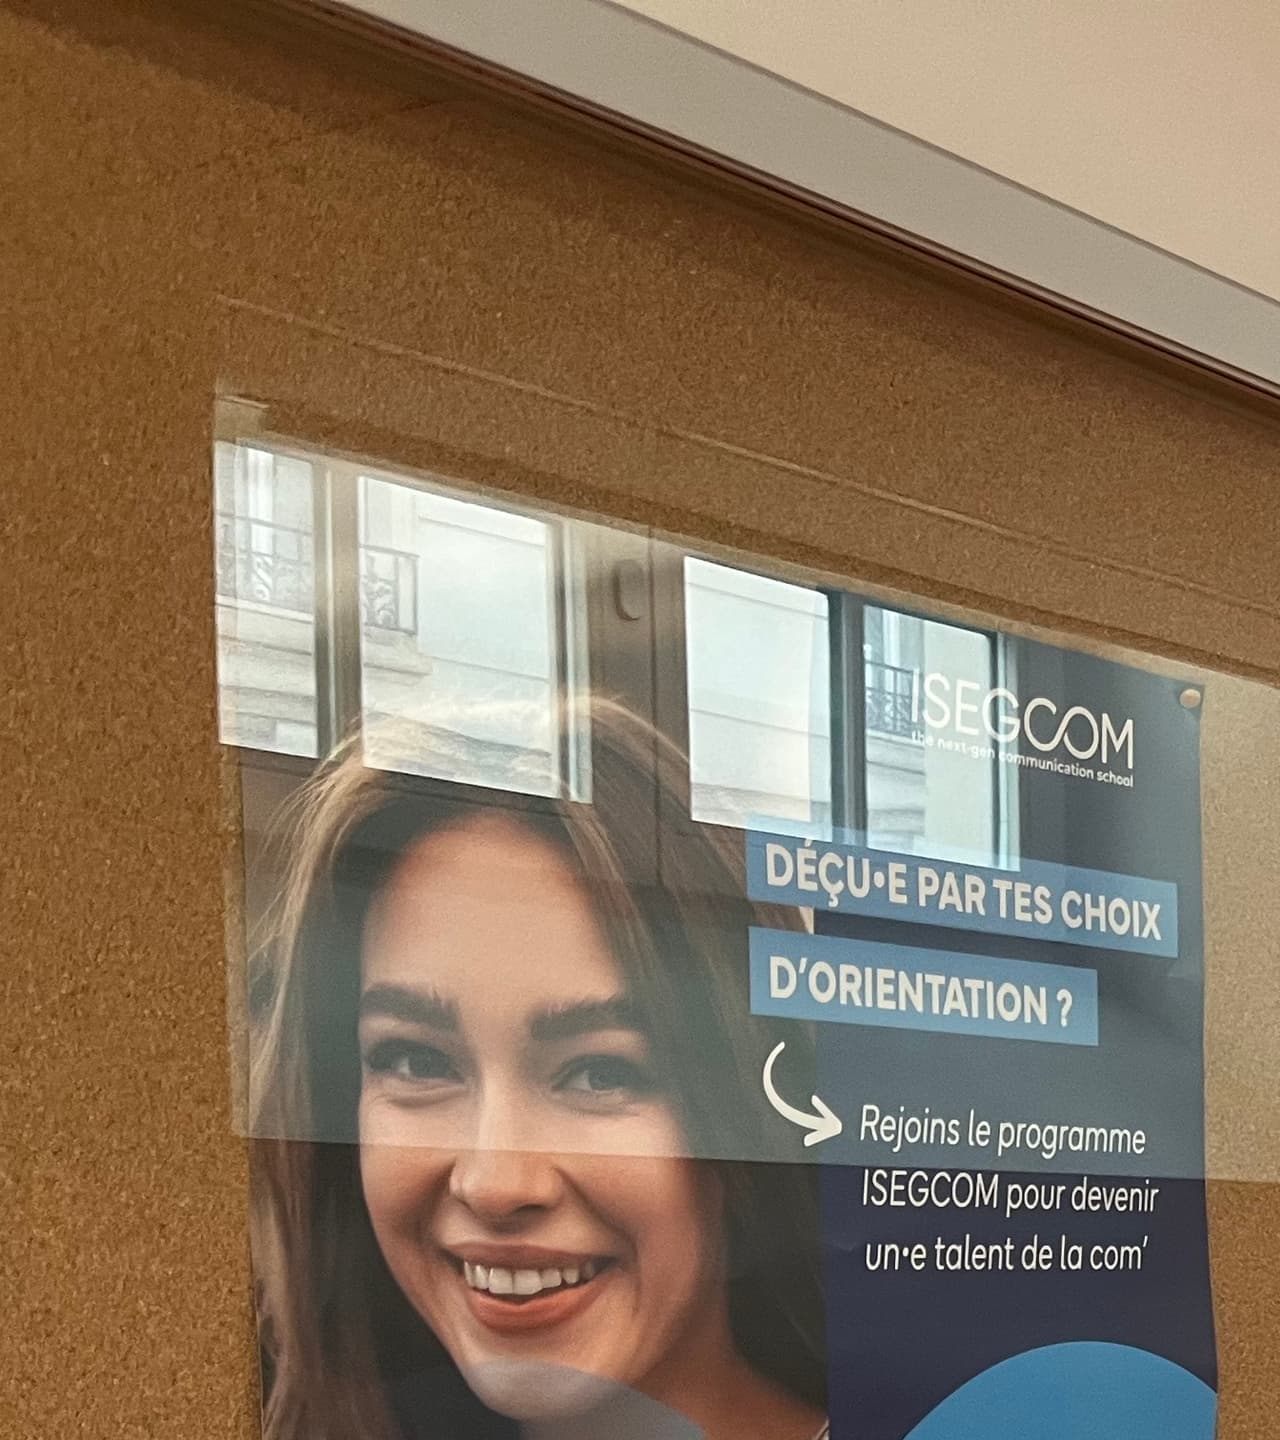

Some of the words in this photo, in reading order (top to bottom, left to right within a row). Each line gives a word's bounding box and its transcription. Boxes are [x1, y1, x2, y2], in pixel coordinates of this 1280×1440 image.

[911, 667, 1134, 769] ISEGCOM
[912, 731, 933, 747] the
[999, 751, 1094, 780] communication
[1097, 770, 1133, 787] school
[918, 867, 985, 916] PAR
[993, 879, 1053, 924] TES
[1061, 890, 1161, 940] CHOIX
[770, 955, 1047, 1025] D'ORIENTATION
[1057, 989, 1073, 1027] ?
[860, 1105, 960, 1152] Rejoins
[967, 1109, 990, 1146] le
[998, 1120, 1146, 1159] programme
[862, 1169, 999, 1208] ISEGCOM
[1006, 1183, 1066, 1218] pour
[1071, 1176, 1159, 1213] devenir
[934, 1234, 1014, 1270] talent
[1021, 1235, 1052, 1270] de
[1060, 1235, 1082, 1270] la
[1090, 1235, 1148, 1270] com'
